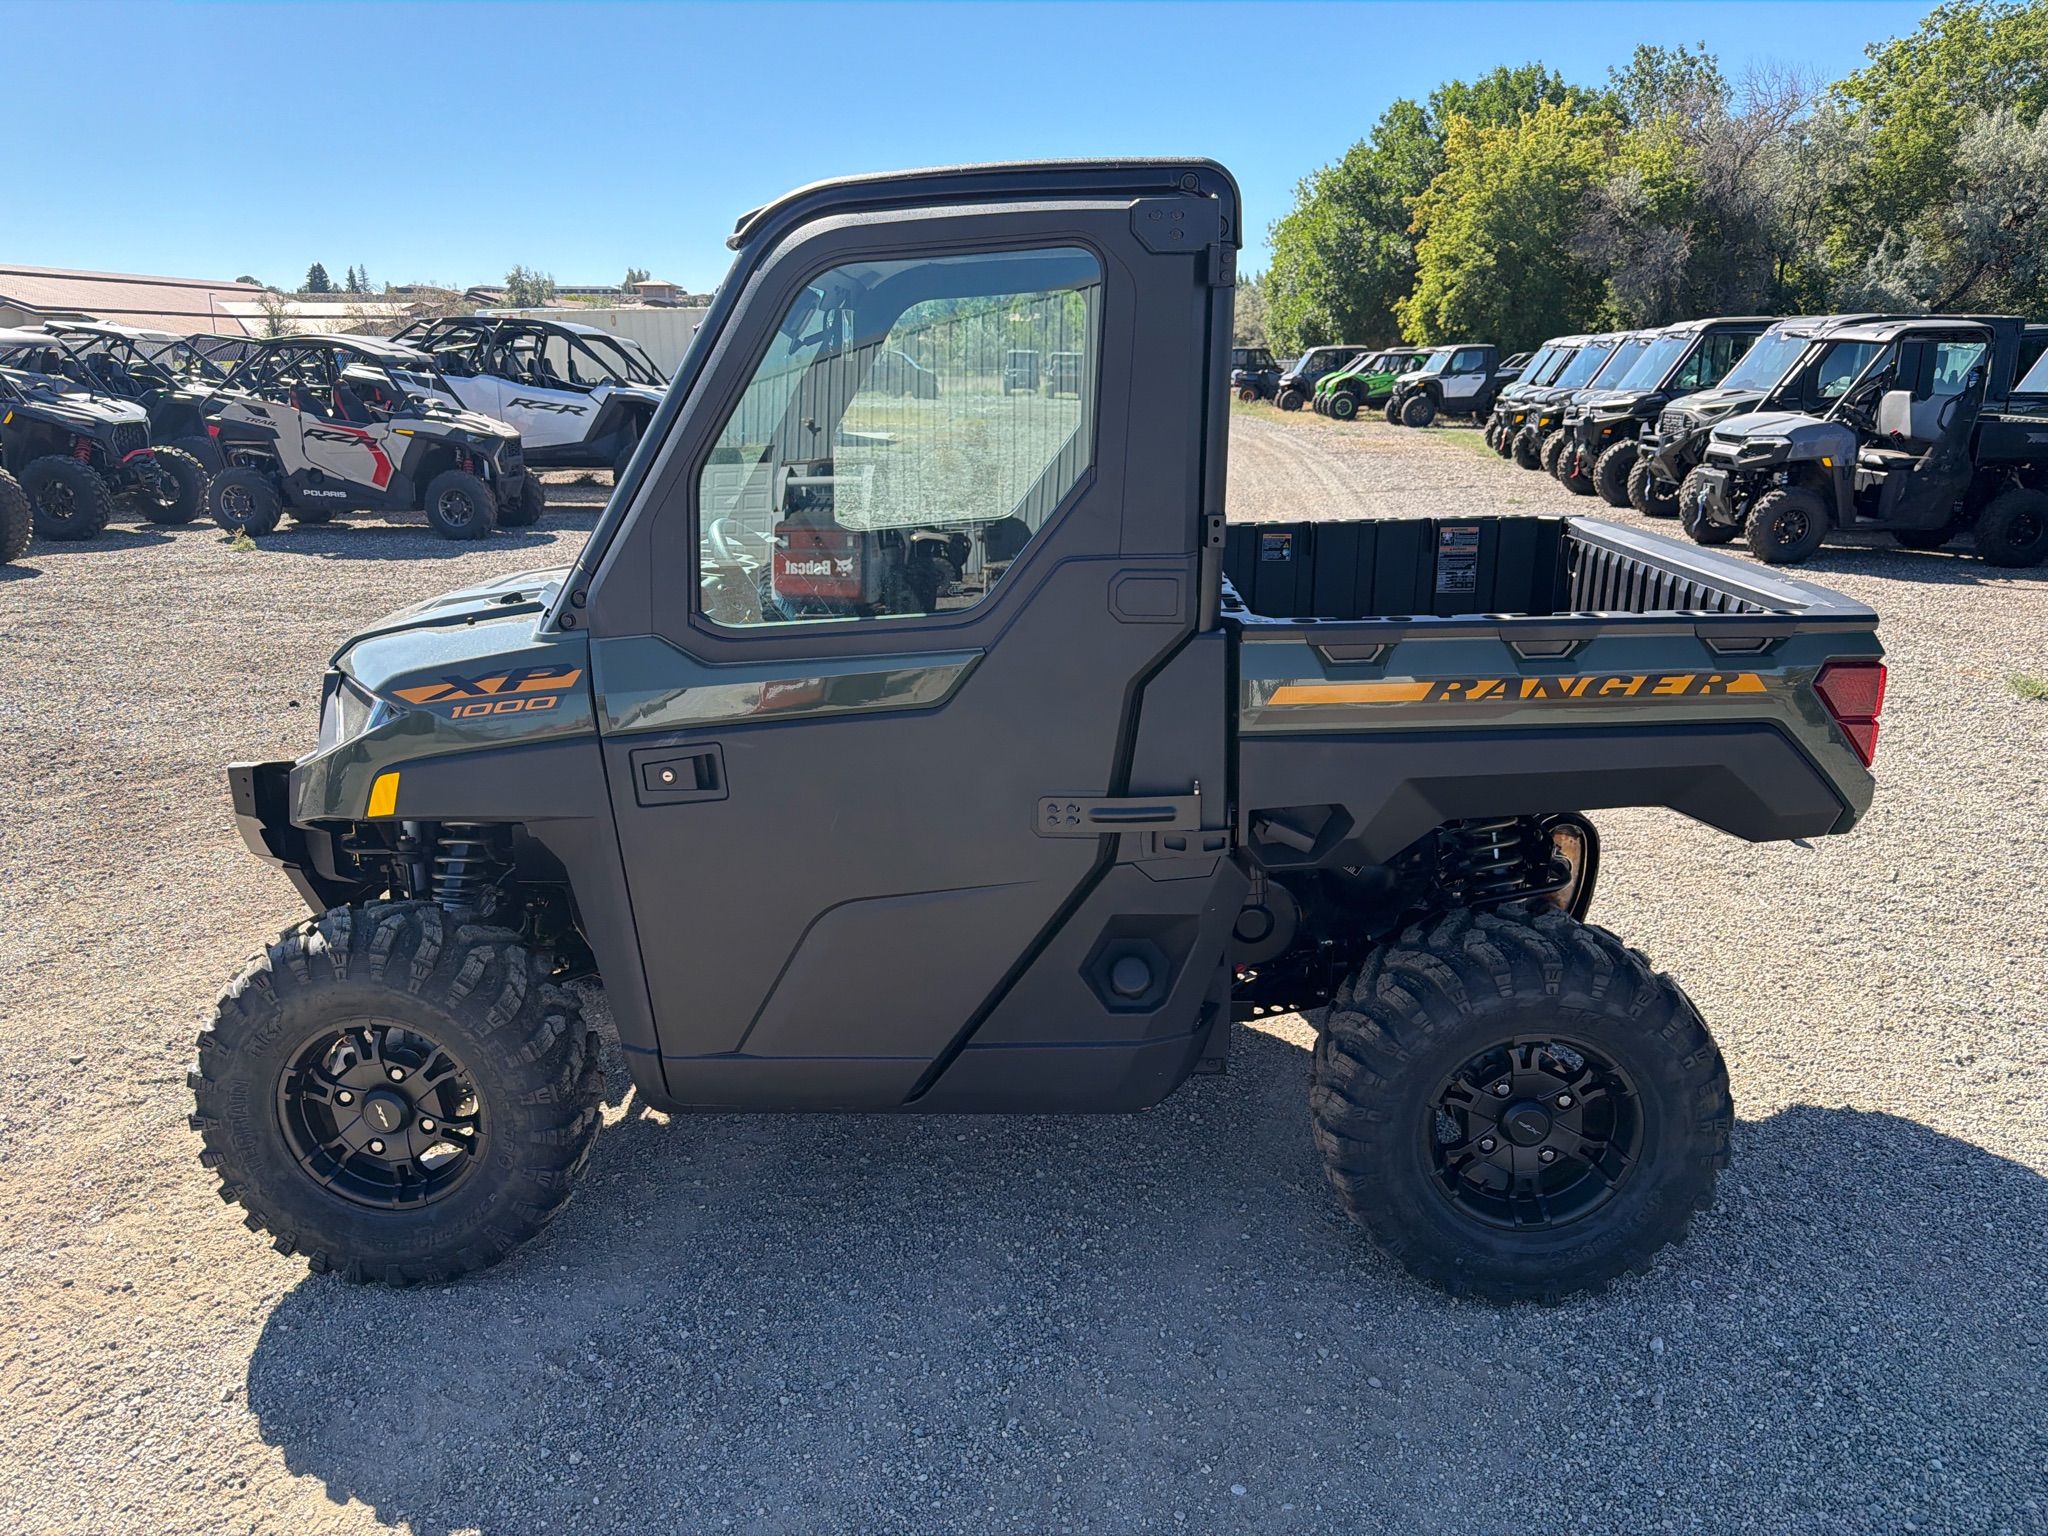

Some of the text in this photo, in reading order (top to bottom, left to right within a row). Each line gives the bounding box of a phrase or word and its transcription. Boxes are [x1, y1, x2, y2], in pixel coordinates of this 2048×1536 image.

[506, 397, 589, 417] RZR
[244, 416, 278, 427] TRAIL
[304, 428, 378, 448] RZR
[303, 489, 347, 498] POLARIS
[420, 663, 577, 702] XP
[1421, 673, 1740, 703] RANGER
[451, 696, 558, 719] 1000
